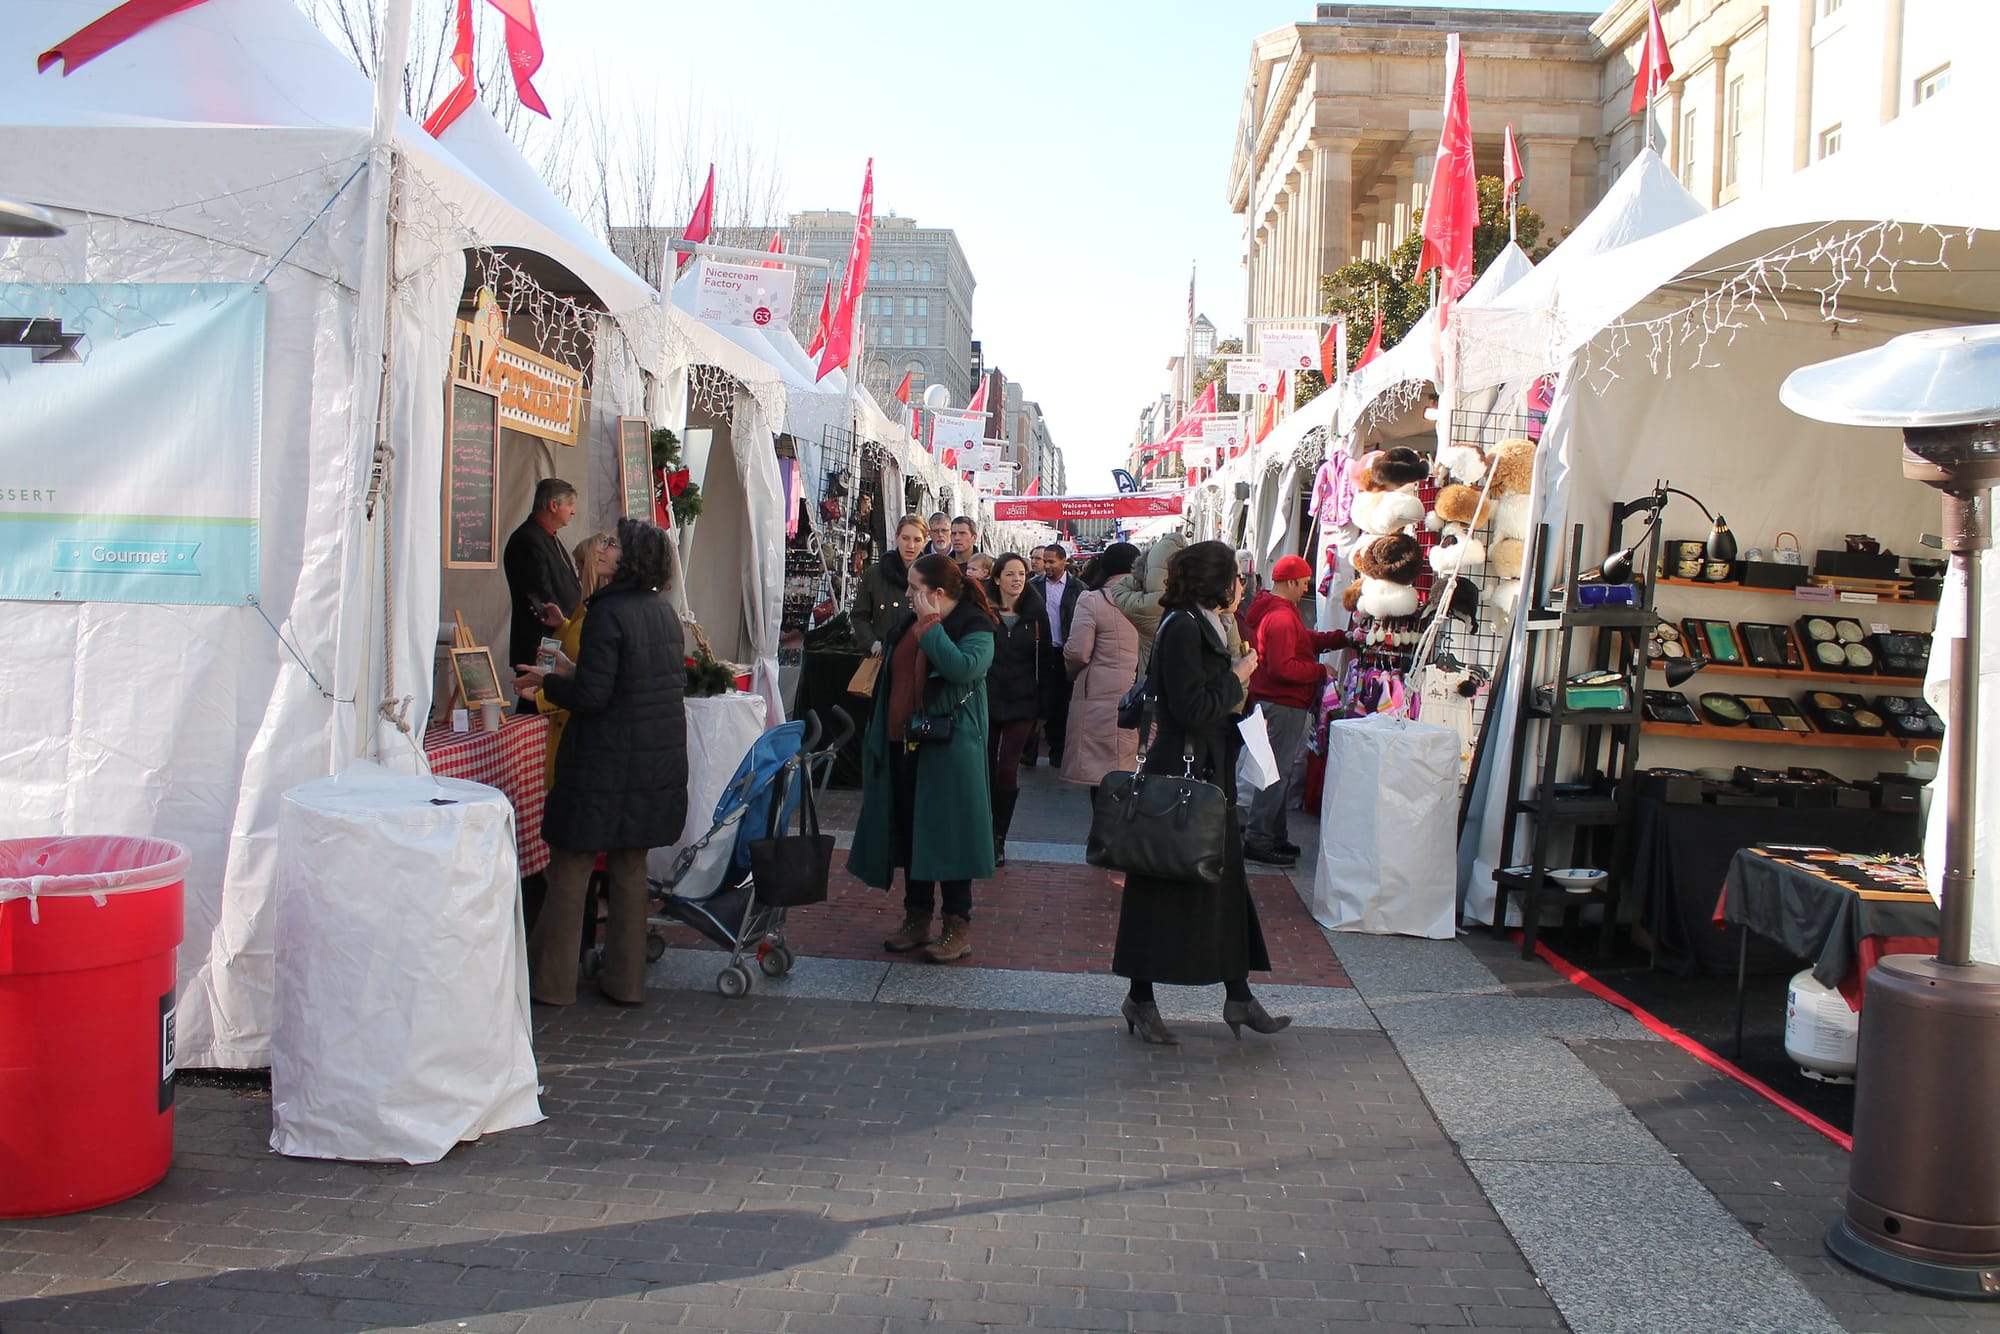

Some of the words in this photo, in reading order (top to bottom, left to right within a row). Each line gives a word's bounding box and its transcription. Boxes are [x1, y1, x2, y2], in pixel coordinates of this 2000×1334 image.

[705, 267, 759, 281] Nicecream
[704, 278, 742, 291] Factory
[754, 311, 770, 323] 63
[1281, 333, 1304, 341] Alpaca
[1301, 358, 1311, 366] 45
[91, 546, 169, 564] Gourmet
